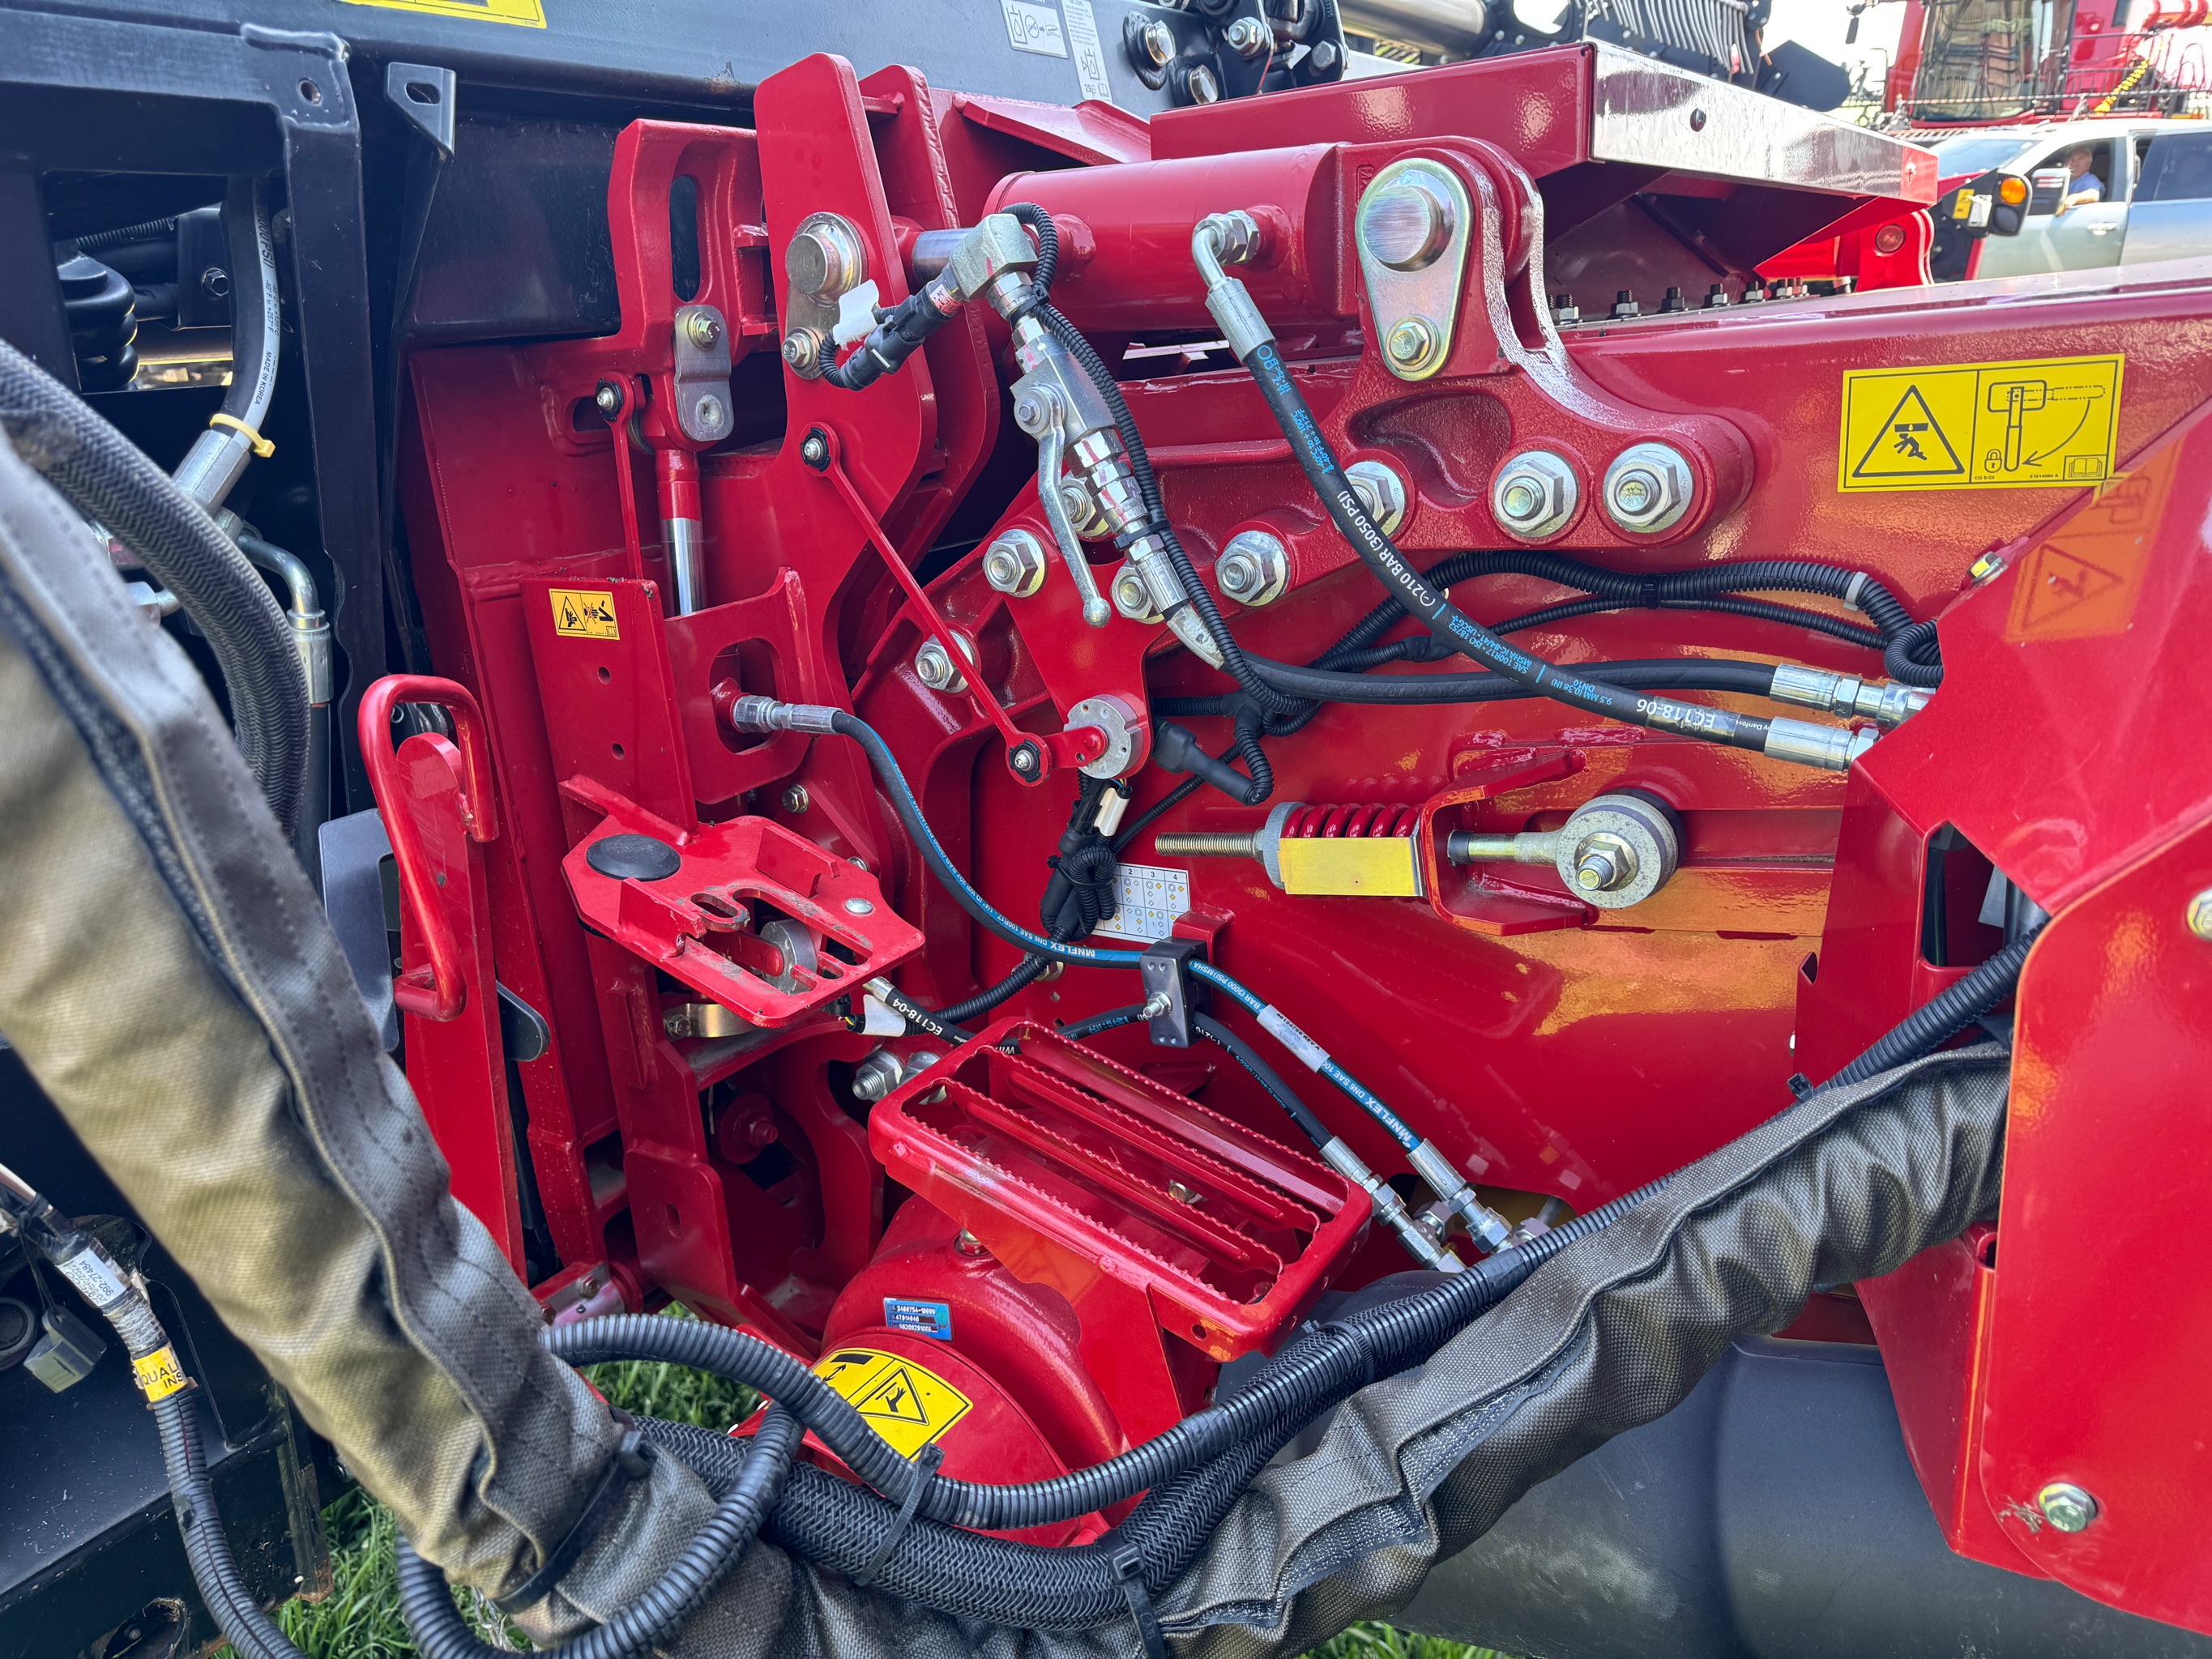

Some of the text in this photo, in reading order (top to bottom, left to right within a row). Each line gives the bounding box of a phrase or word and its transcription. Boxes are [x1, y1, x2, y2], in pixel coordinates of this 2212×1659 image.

[254, 382, 266, 405] KOREA
[1290, 412, 1307, 433] 100°C
[1297, 409, 1313, 430] 212°F
[1307, 439, 1315, 449] to
[1314, 436, 1322, 446] to
[1337, 490, 1424, 597] 210 BAR (3050 PSI)
[1448, 623, 1529, 675] SAE 100R17 ISO 18752
[1458, 618, 1532, 667] MSHA IC-84/41 USCG
[1551, 678, 1613, 706] 9.5 MM (0.38 IN)
[1573, 679, 1595, 692] DN10
[1636, 699, 1717, 729] EC118-06
[1735, 719, 1762, 731] Danfoss
[976, 894, 983, 903] ID
[997, 915, 1019, 932] 100R17
[1019, 929, 1033, 940] SAE
[1034, 936, 1047, 946] DN6
[1050, 940, 1095, 957] MNFLEX
[1227, 980, 1249, 999] (3000
[1245, 993, 1262, 1010] BAR
[892, 998, 943, 1036] EC118-04
[1333, 1070, 1351, 1088] SAE
[1349, 1083, 1366, 1098] DN6
[1365, 1097, 1412, 1142] MNFLEX
[79, 1260, 114, 1296] 992-27484
